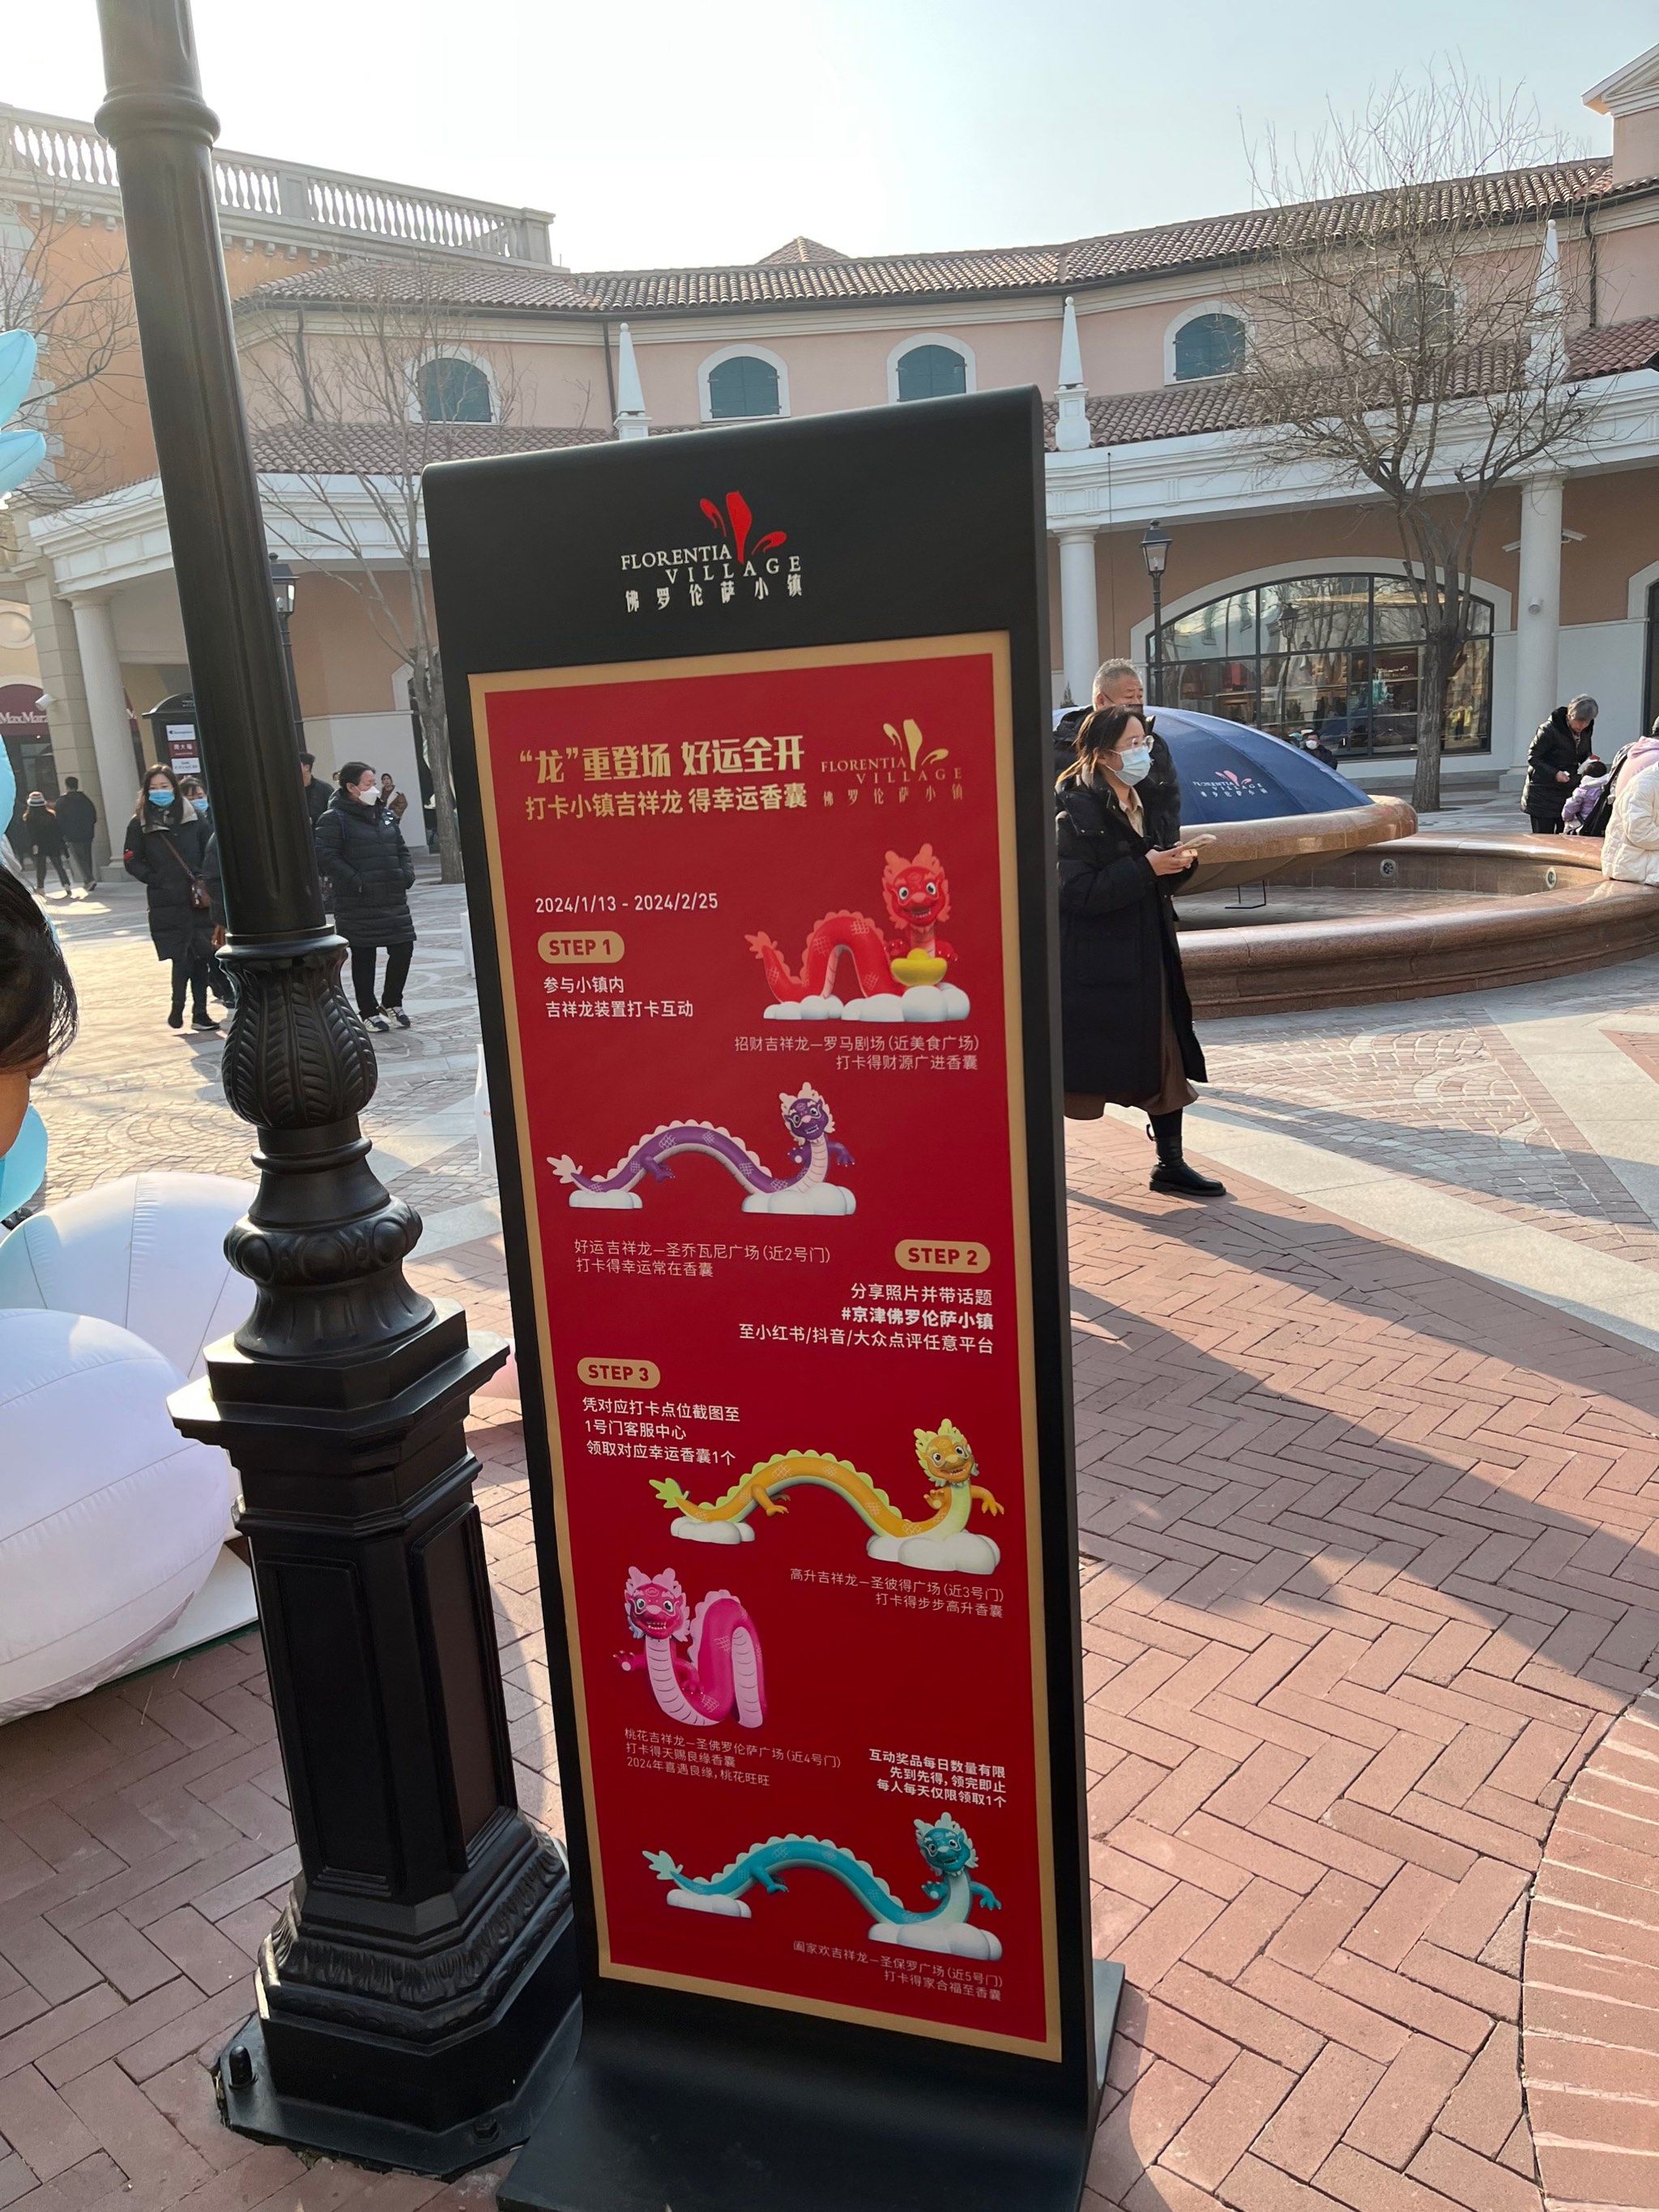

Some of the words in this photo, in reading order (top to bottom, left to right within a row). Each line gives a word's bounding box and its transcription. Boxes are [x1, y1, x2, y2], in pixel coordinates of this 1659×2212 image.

[621, 544, 732, 570] FLORENTIA
[664, 555, 801, 584] VILLAGE
[625, 574, 802, 613] 佛罗伦萨小镇
[680, 735, 804, 776] 好运全开
[821, 757, 906, 772] FLORENTIA
[856, 767, 962, 784] VILLAGE
[526, 789, 684, 821] 打卡小镇吉祥龙
[689, 782, 807, 813] 得幸运香囊
[823, 783, 963, 807] 佛罗伦萨小镇
[535, 895, 616, 914] 2024/1/13
[634, 892, 719, 911] 2024/2/25
[549, 940, 596, 956] STEP
[603, 939, 611, 955] 1
[544, 976, 625, 993] 参与小镇内
[545, 1000, 693, 1018] 吉祥龙装置打卡互动
[836, 1054, 978, 1070] 打卡得财源广进香囊
[576, 1258, 714, 1278] 打卡得幸运常在香囊
[907, 1247, 960, 1266] STEP
[966, 1249, 978, 1266] 2
[851, 1282, 993, 1306] 分享照片并带话题
[841, 1306, 994, 1330] #京津佛罗伦萨小镇
[739, 1323, 993, 1354] 至小红书/抖音/大众点评任意平台
[588, 1364, 633, 1381] STEP
[639, 1368, 649, 1381] 3
[582, 1397, 740, 1422] 凭对应打卡点位截图至
[585, 1420, 687, 1440] 1号门客服中心
[586, 1440, 736, 1466] 领取对应幸运香囊1个
[875, 1592, 1003, 1619] 打卡得步步高升香囊
[625, 1742, 736, 1768] 打卡得天赐良缘香囊
[869, 1749, 1006, 1779] 互动奖品每日数量有限
[876, 1779, 1006, 1808] 每人每天仅限领取1个
[884, 1970, 1002, 2001] 打卡得家合福至香囊
